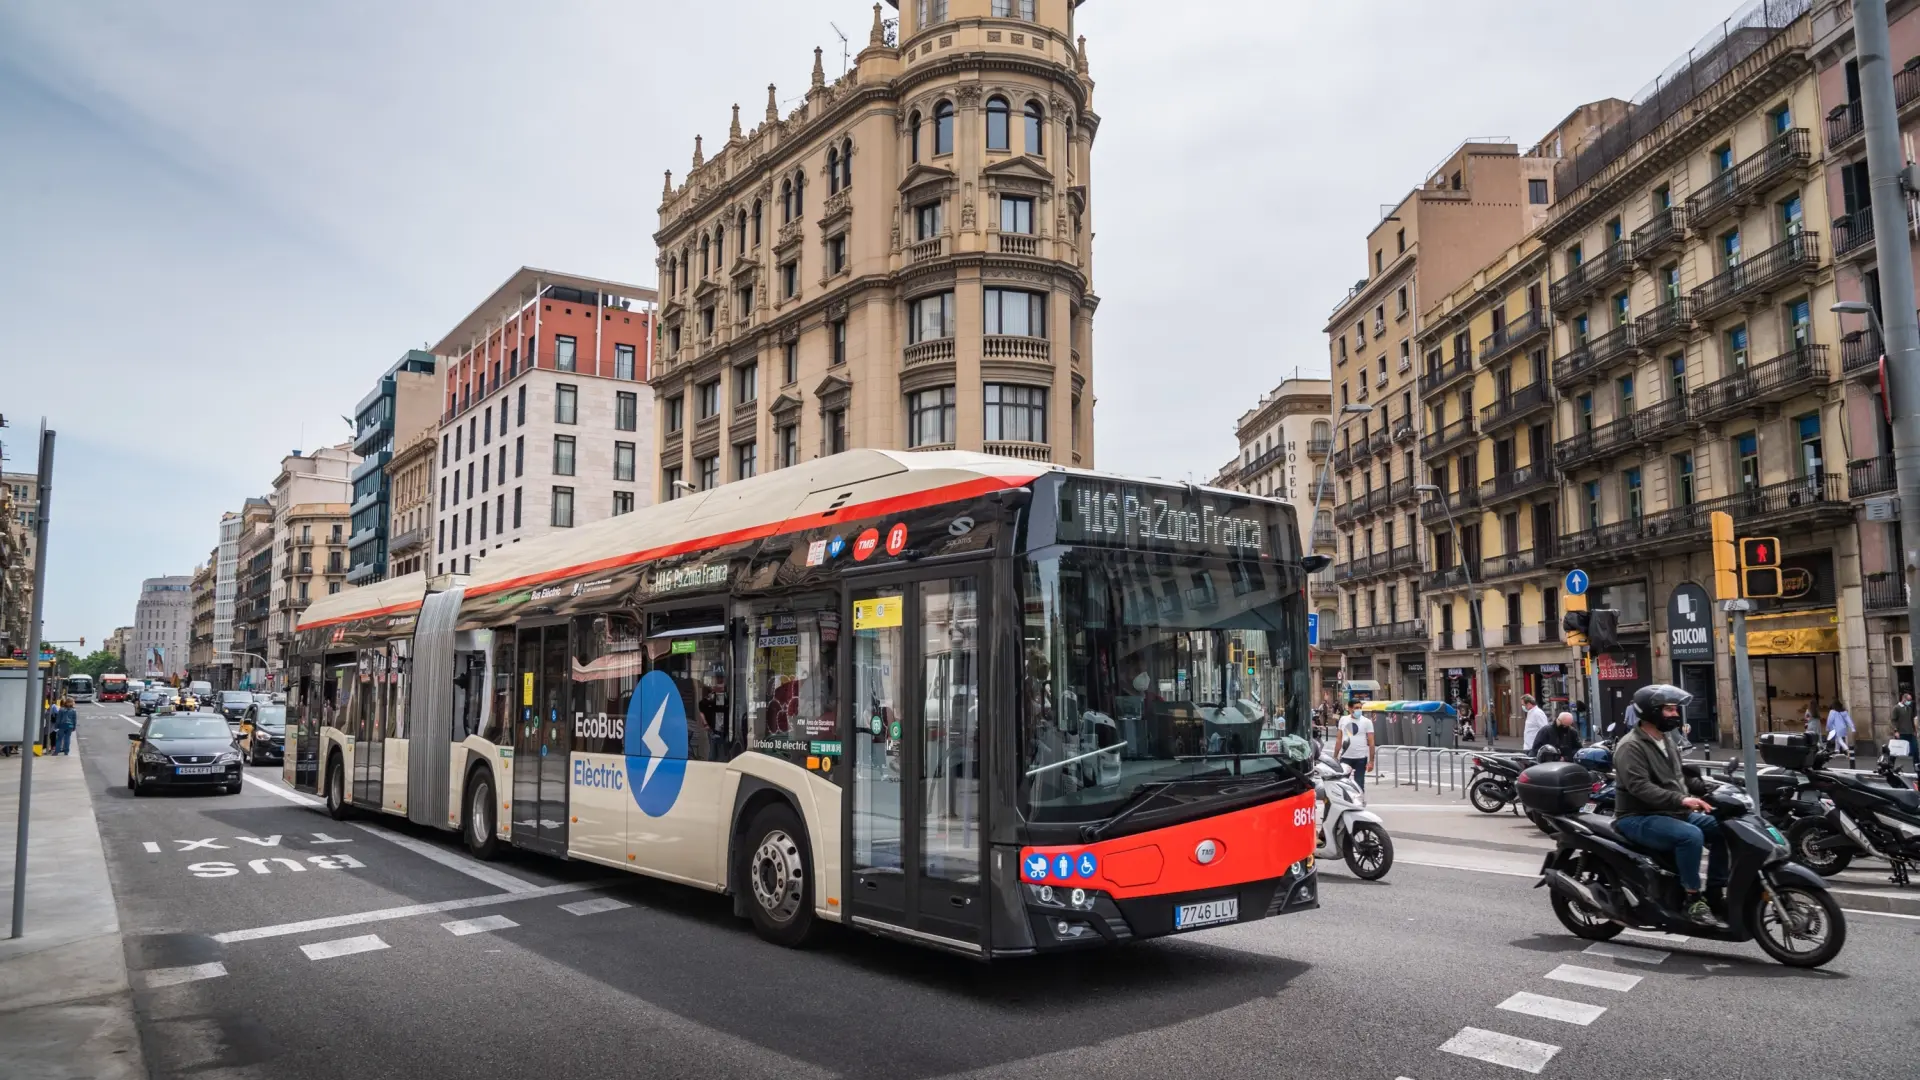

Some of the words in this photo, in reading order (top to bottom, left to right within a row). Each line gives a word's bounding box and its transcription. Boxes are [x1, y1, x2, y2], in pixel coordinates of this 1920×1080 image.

[1288, 440, 1297, 499] HOTEL
[1203, 505, 1262, 549] Franca
[858, 538, 875, 550] TMB
[890, 529, 903, 549] B
[655, 570, 672, 592] H16
[702, 564, 728, 584] Franca
[531, 590, 541, 600] Bus
[1672, 627, 1707, 645] STUCOM
[575, 712, 624, 739] EcoBus
[753, 740, 774, 749] Urbino
[775, 740, 782, 749] 18
[782, 741, 808, 751] electric
[574, 758, 623, 791] Elèctric
[1293, 807, 1316, 827] 8614
[142, 832, 354, 853] TAXI
[187, 853, 367, 878] BUS
[1183, 904, 1212, 923] 7746
[1214, 900, 1235, 918] LLV
